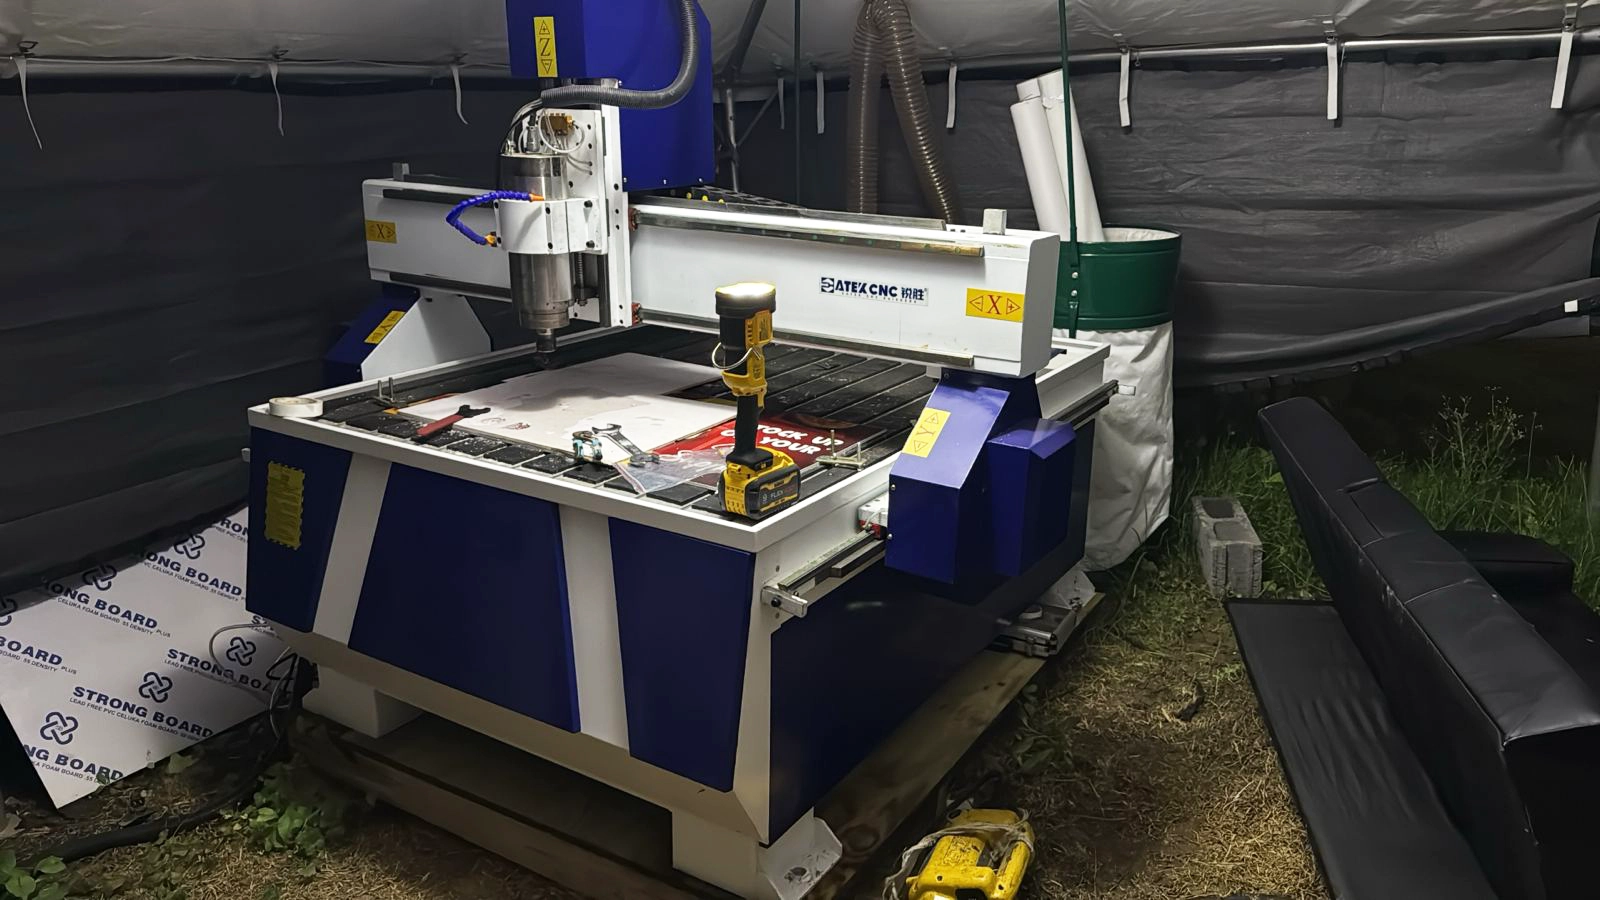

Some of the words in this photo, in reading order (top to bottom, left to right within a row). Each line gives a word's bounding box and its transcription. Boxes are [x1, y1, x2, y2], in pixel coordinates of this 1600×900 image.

[540, 37, 551, 56] Z
[376, 223, 386, 240] X
[869, 284, 898, 297] CNC
[987, 294, 1002, 315] X
[757, 424, 808, 440] TOCK
[915, 424, 936, 437] Y
[720, 429, 736, 438] O
[759, 436, 821, 454] YOUR
[147, 552, 181, 572] ONG
[186, 567, 242, 596] BOARD
[52, 583, 90, 605] ONG
[95, 599, 158, 629] BOARD
[69, 697, 86, 706] LEAD
[86, 703, 102, 711] FREE
[103, 708, 116, 716] PVC
[73, 686, 148, 718] STRONG
[153, 711, 214, 738] BOARD
[24, 744, 49, 761] NG
[55, 754, 124, 781] BOARD
[41, 763, 60, 772] FOAM
[61, 768, 84, 779] BOARD
